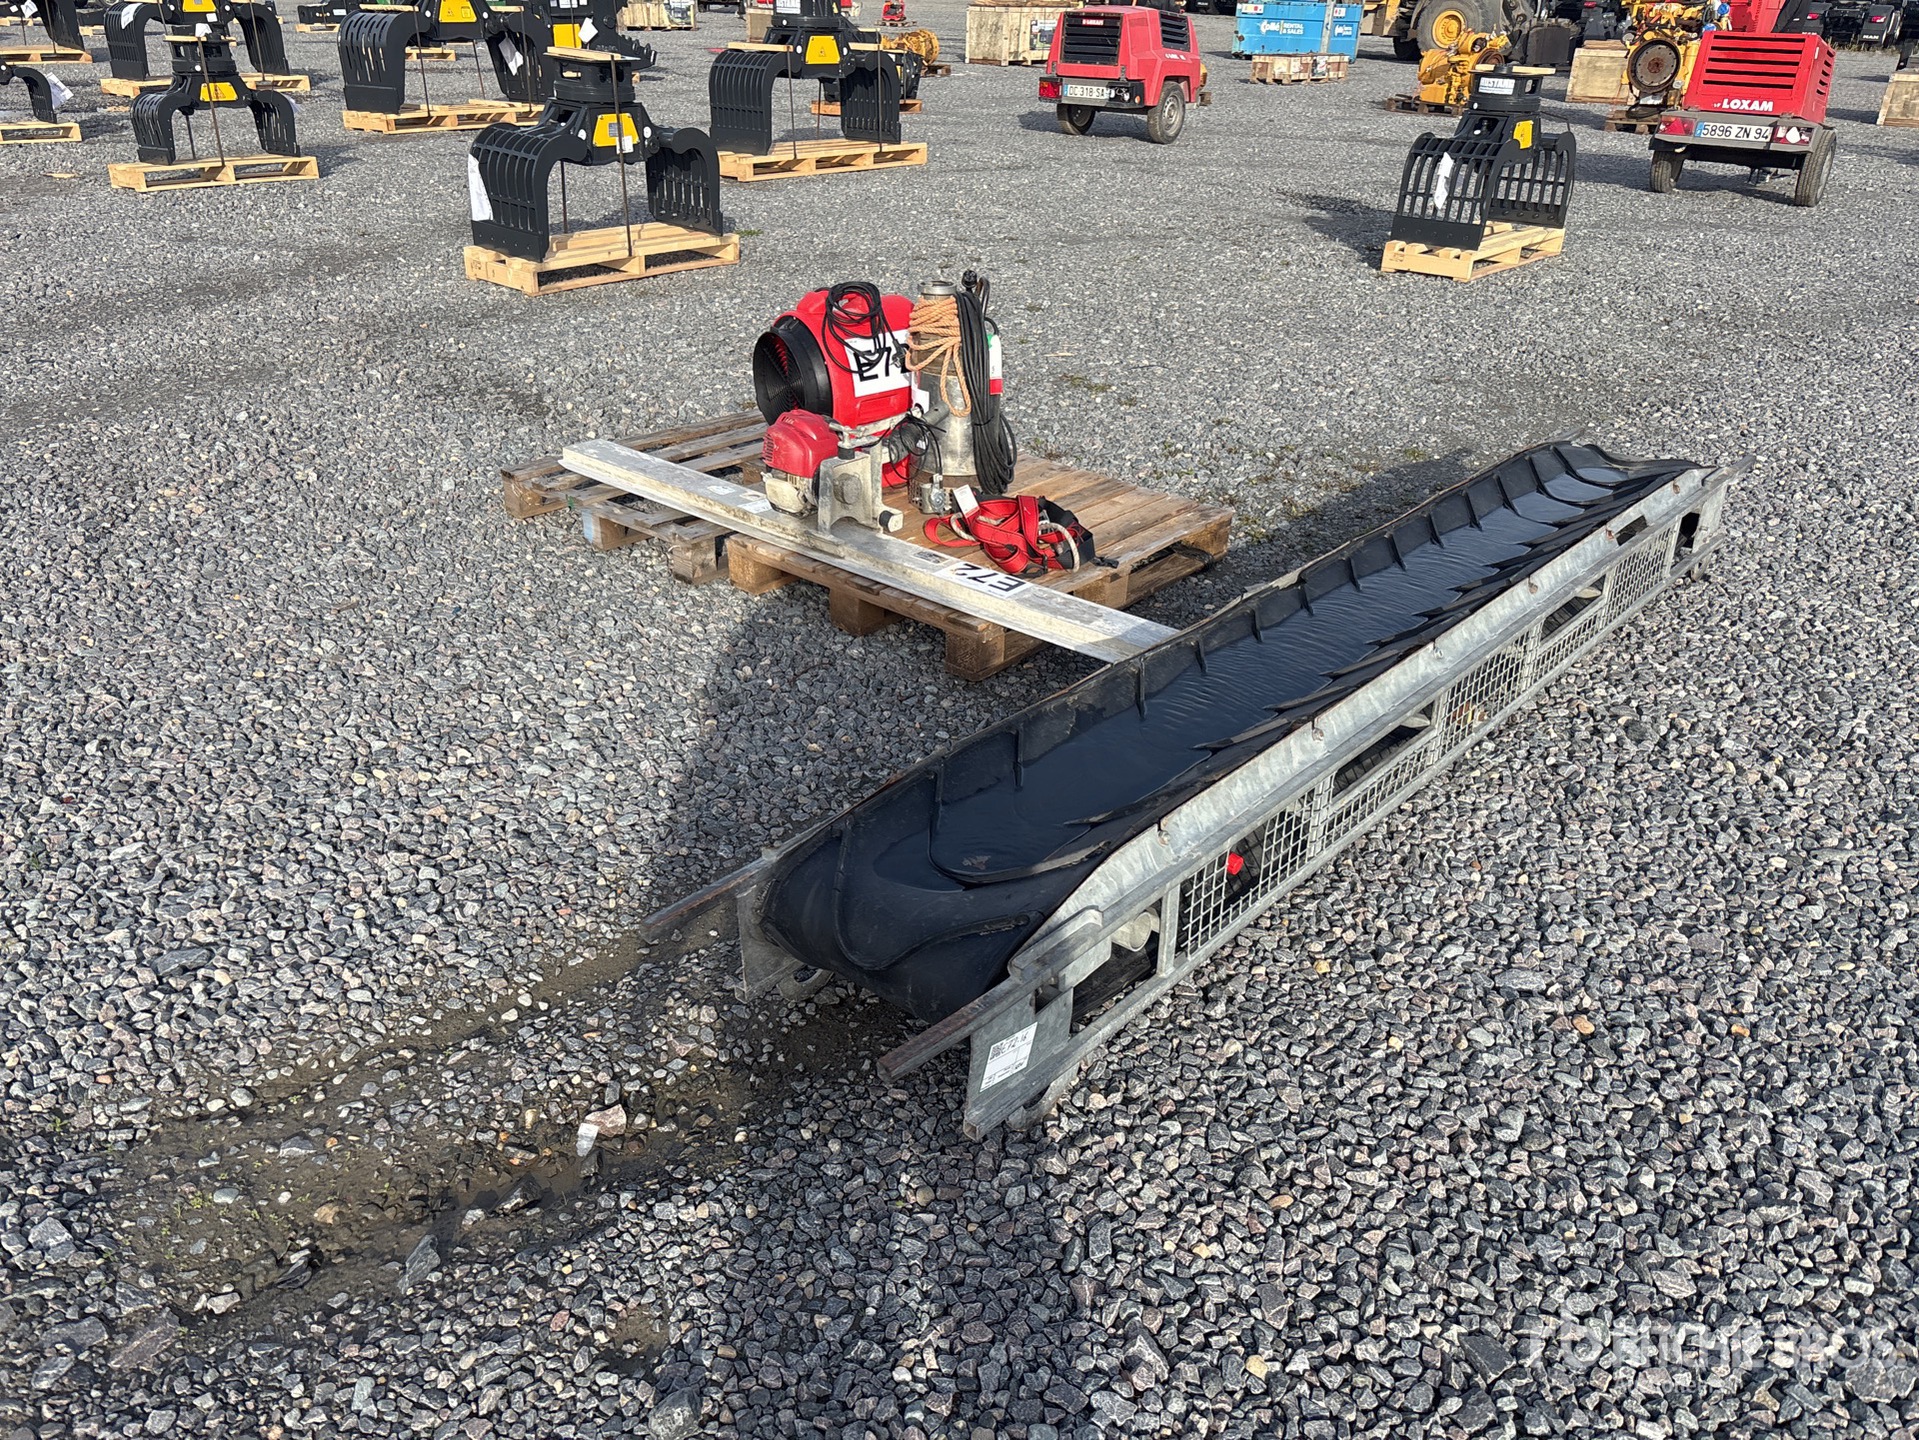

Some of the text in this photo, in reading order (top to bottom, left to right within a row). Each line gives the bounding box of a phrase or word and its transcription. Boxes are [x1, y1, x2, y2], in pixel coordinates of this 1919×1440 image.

[1722, 98, 1773, 112] LOXAM
[1702, 124, 1769, 140] 5896 ZN 94
[954, 563, 1026, 592] E72
